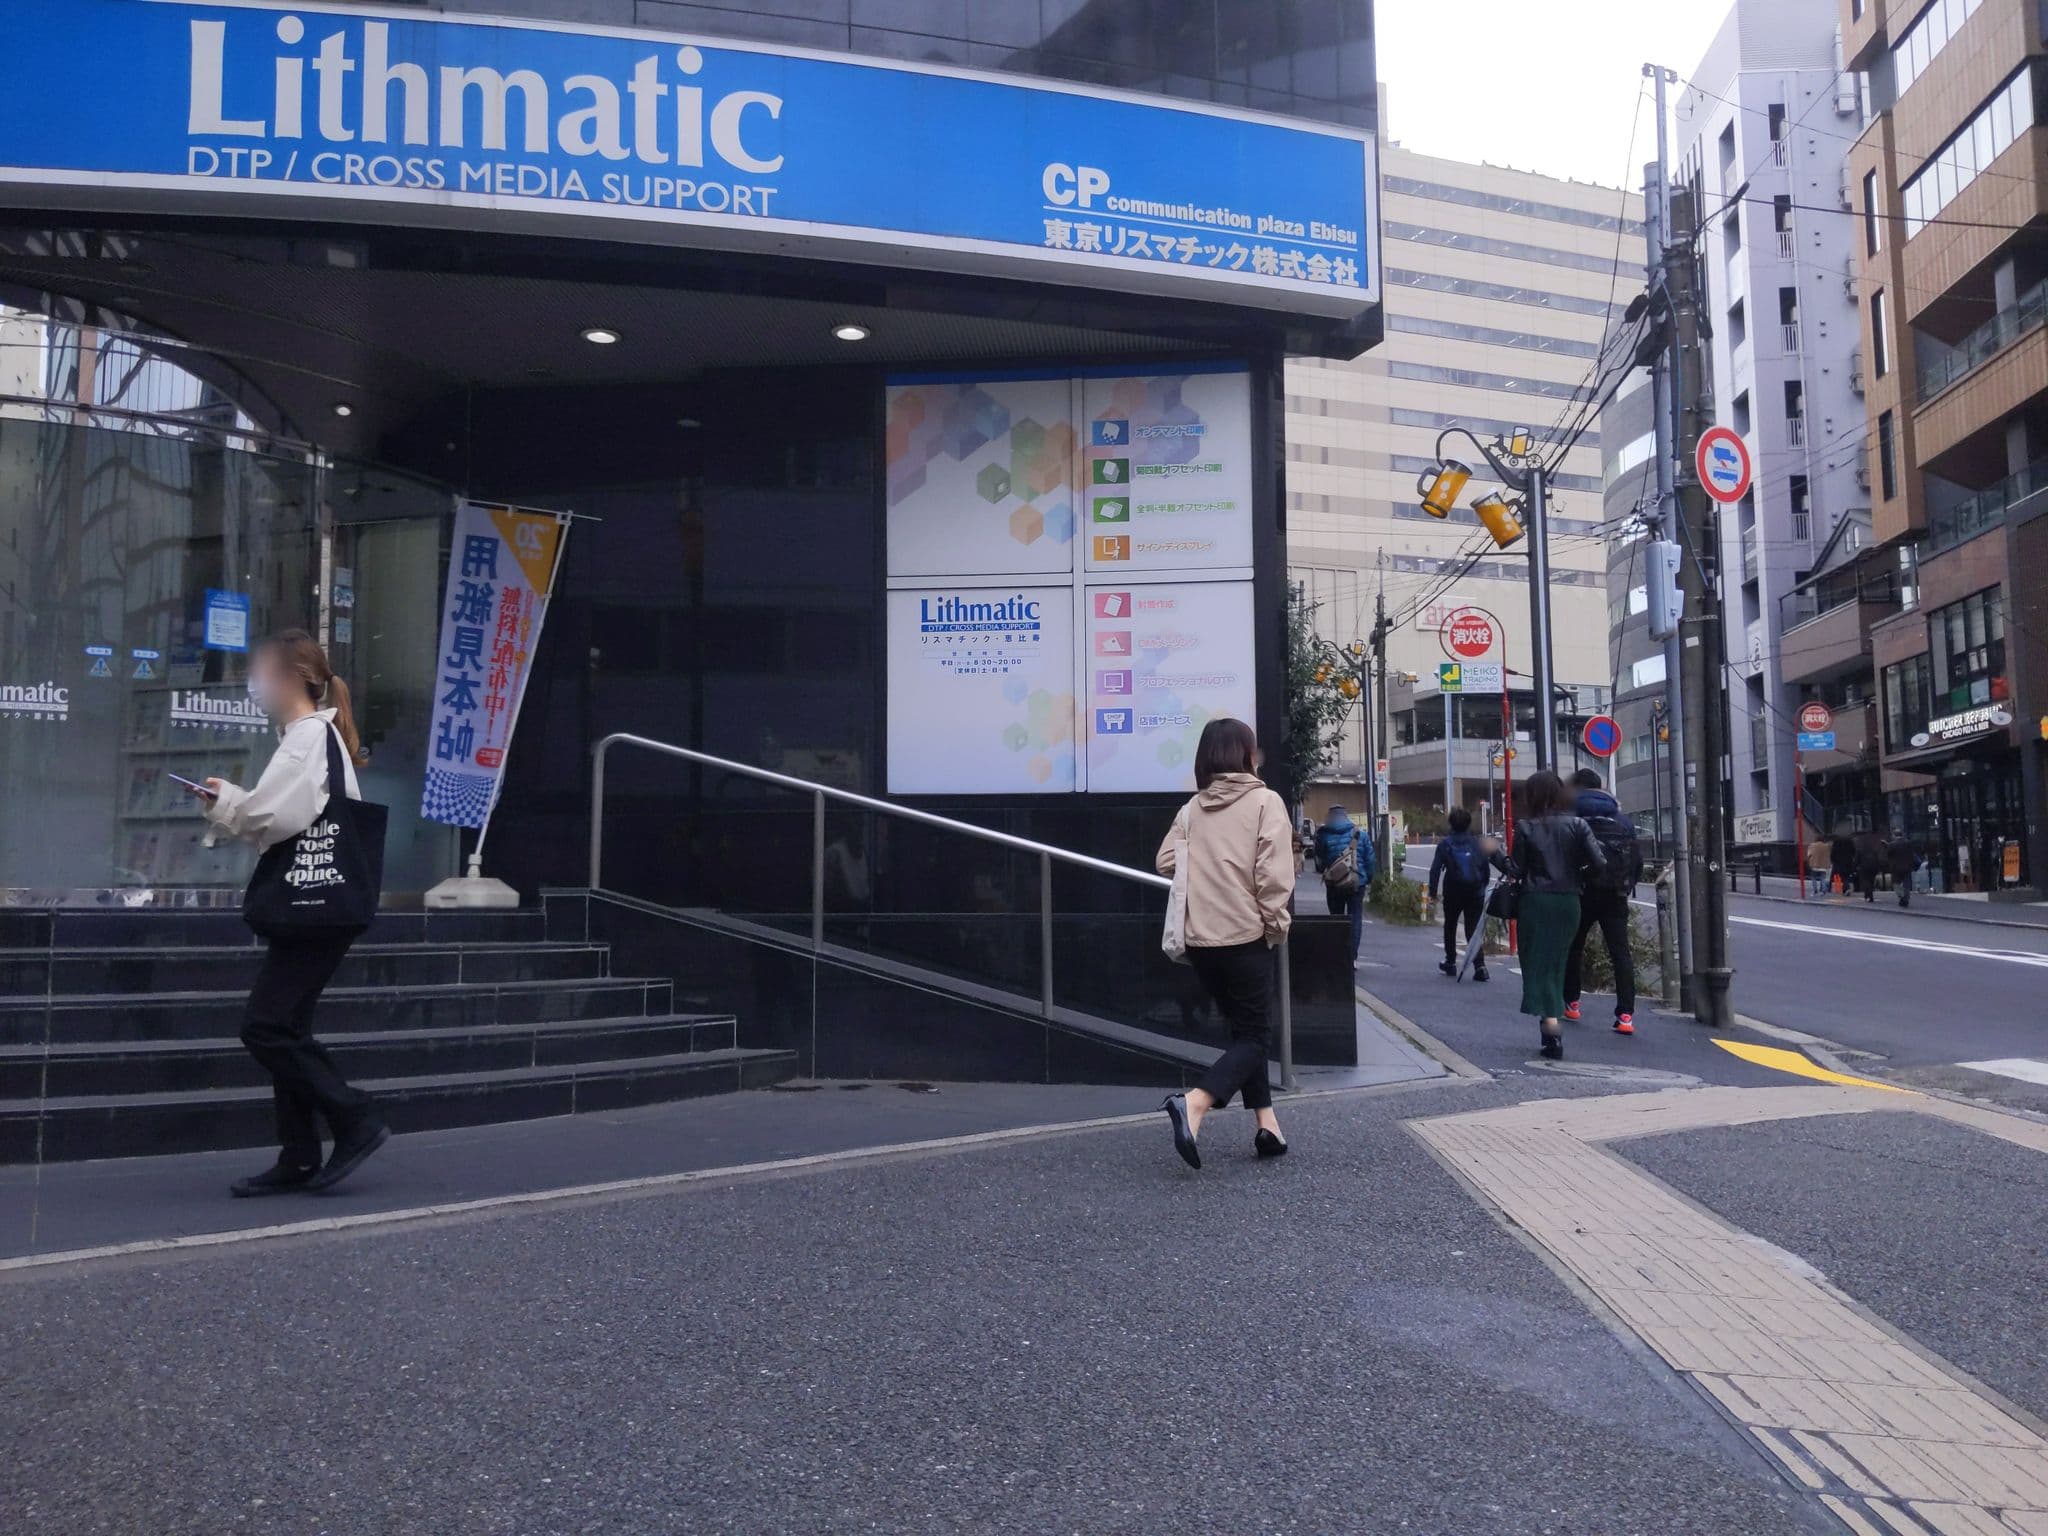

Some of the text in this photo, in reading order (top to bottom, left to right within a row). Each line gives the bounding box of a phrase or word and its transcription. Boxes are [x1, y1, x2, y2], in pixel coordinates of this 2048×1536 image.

[189, 16, 784, 174] Lithmatic
[188, 147, 778, 218] DTP / CROSS MEDIA SUPPORT
[1042, 162, 1358, 244] CP communication plaza Ebisu
[1043, 218, 1359, 287] 東京リスマチック株式会社
[921, 594, 1040, 623] Lithmatic
[949, 624, 974, 632] CROSS
[976, 623, 999, 631] MEDIA
[1001, 622, 1034, 631] SUPPORT
[1453, 628, 1490, 645] 消火栓
[1463, 667, 1498, 676] MEIKO
[1463, 676, 1498, 684] TRADING
[0, 680, 68, 703] matic
[300, 819, 340, 838] ulle
[296, 837, 334, 852] rose
[294, 851, 334, 866] sans
